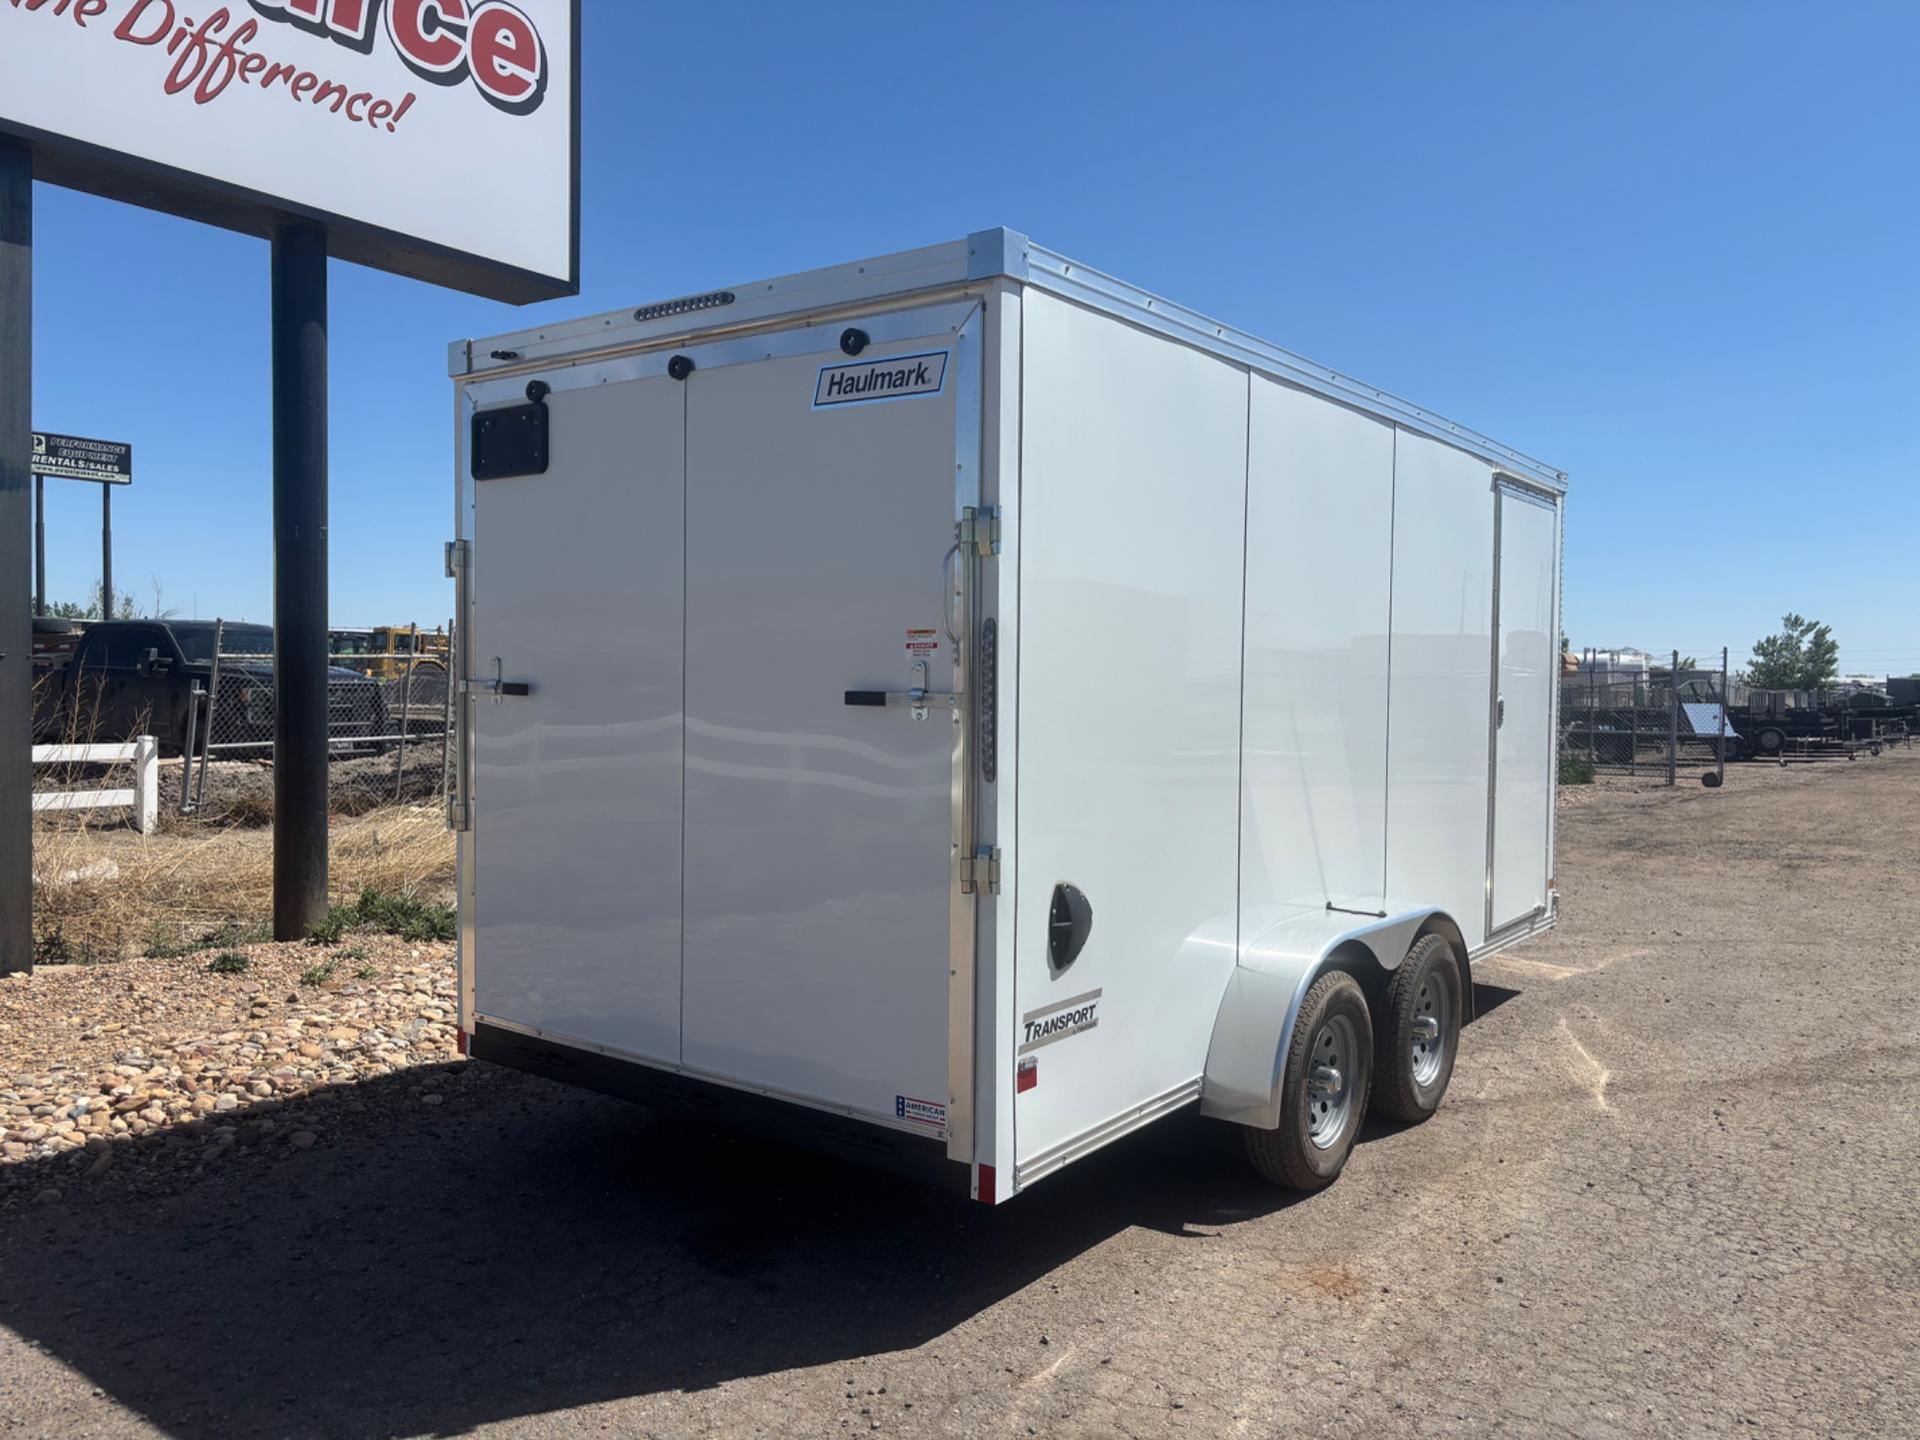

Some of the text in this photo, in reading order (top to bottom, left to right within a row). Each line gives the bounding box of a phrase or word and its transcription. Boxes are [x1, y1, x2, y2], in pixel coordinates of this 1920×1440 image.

[114, 0, 415, 132] Difference!
[827, 362, 929, 396] Haulmark
[1024, 1004, 1096, 1043] TRANSPORT
[906, 1101, 945, 1117] AMERICAN
